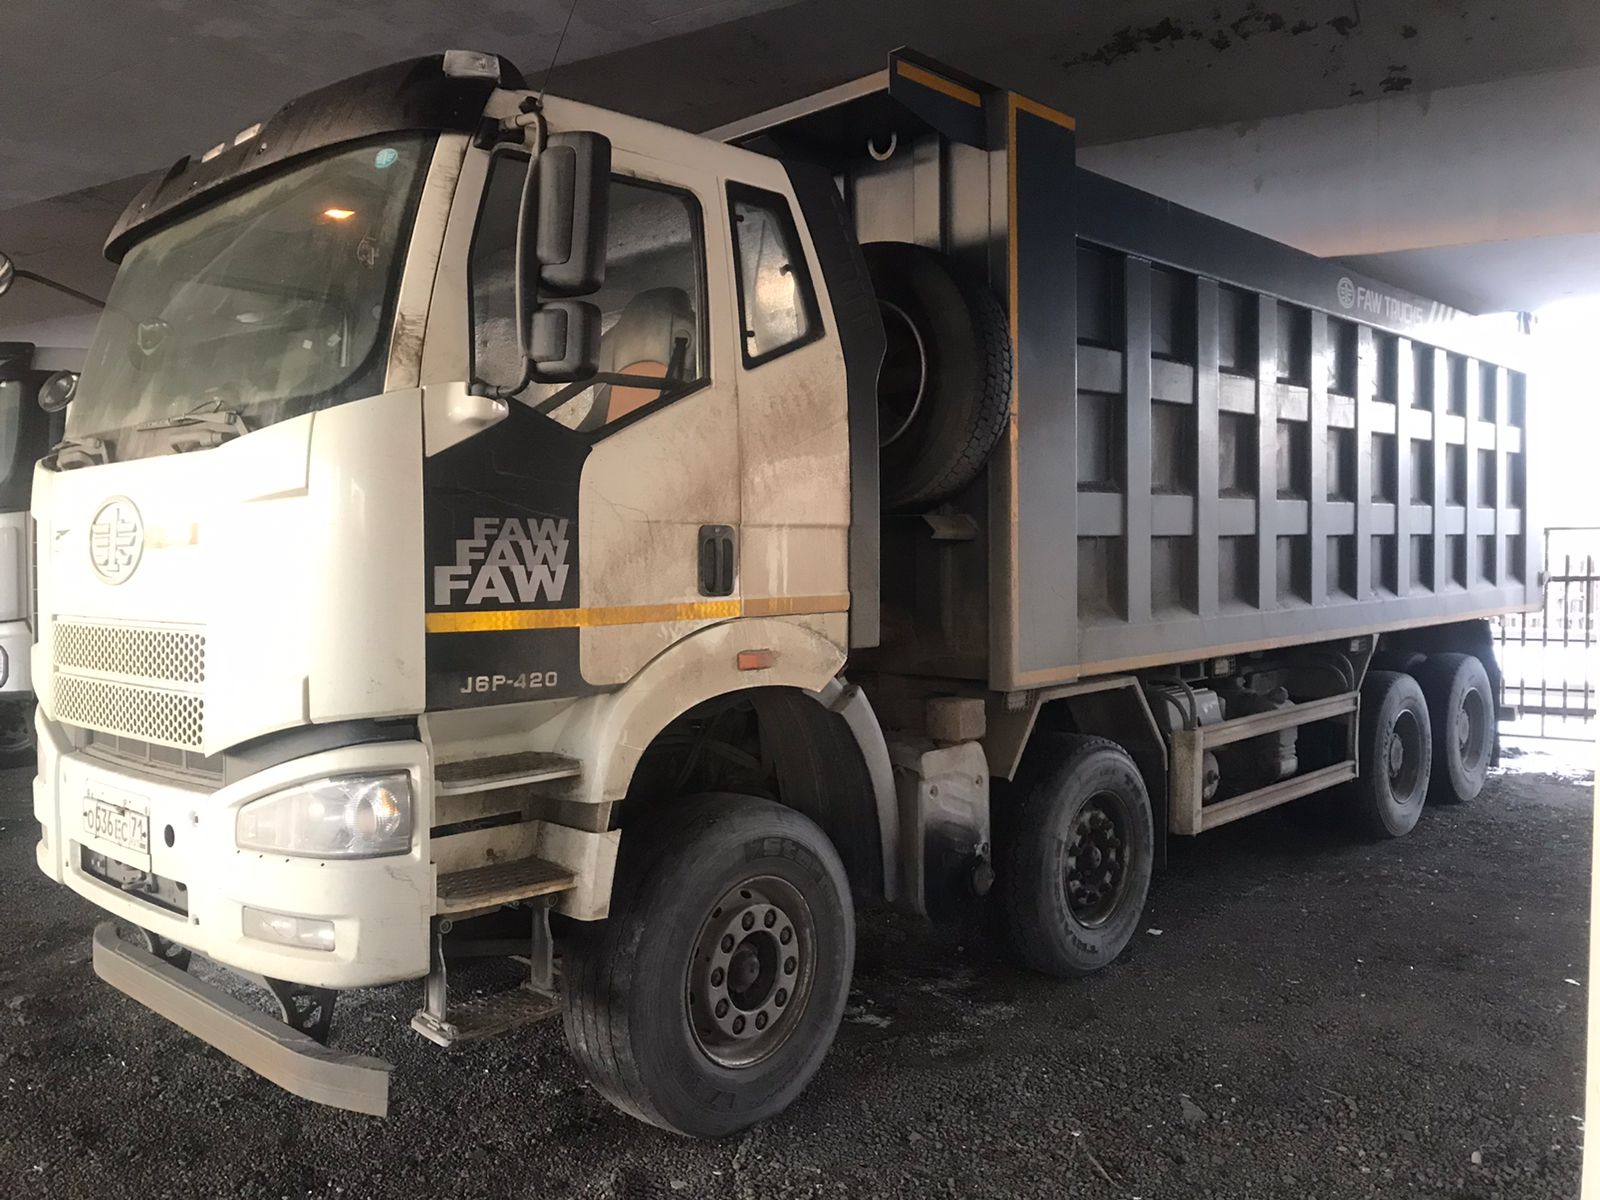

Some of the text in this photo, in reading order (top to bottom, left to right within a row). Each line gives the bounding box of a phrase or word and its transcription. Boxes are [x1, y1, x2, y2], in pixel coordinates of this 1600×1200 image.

[1357, 286, 1383, 315] FAW
[473, 517, 569, 546] FAW
[456, 539, 570, 571] FAW
[434, 564, 570, 605] FAW
[460, 671, 558, 694] J6P-420
